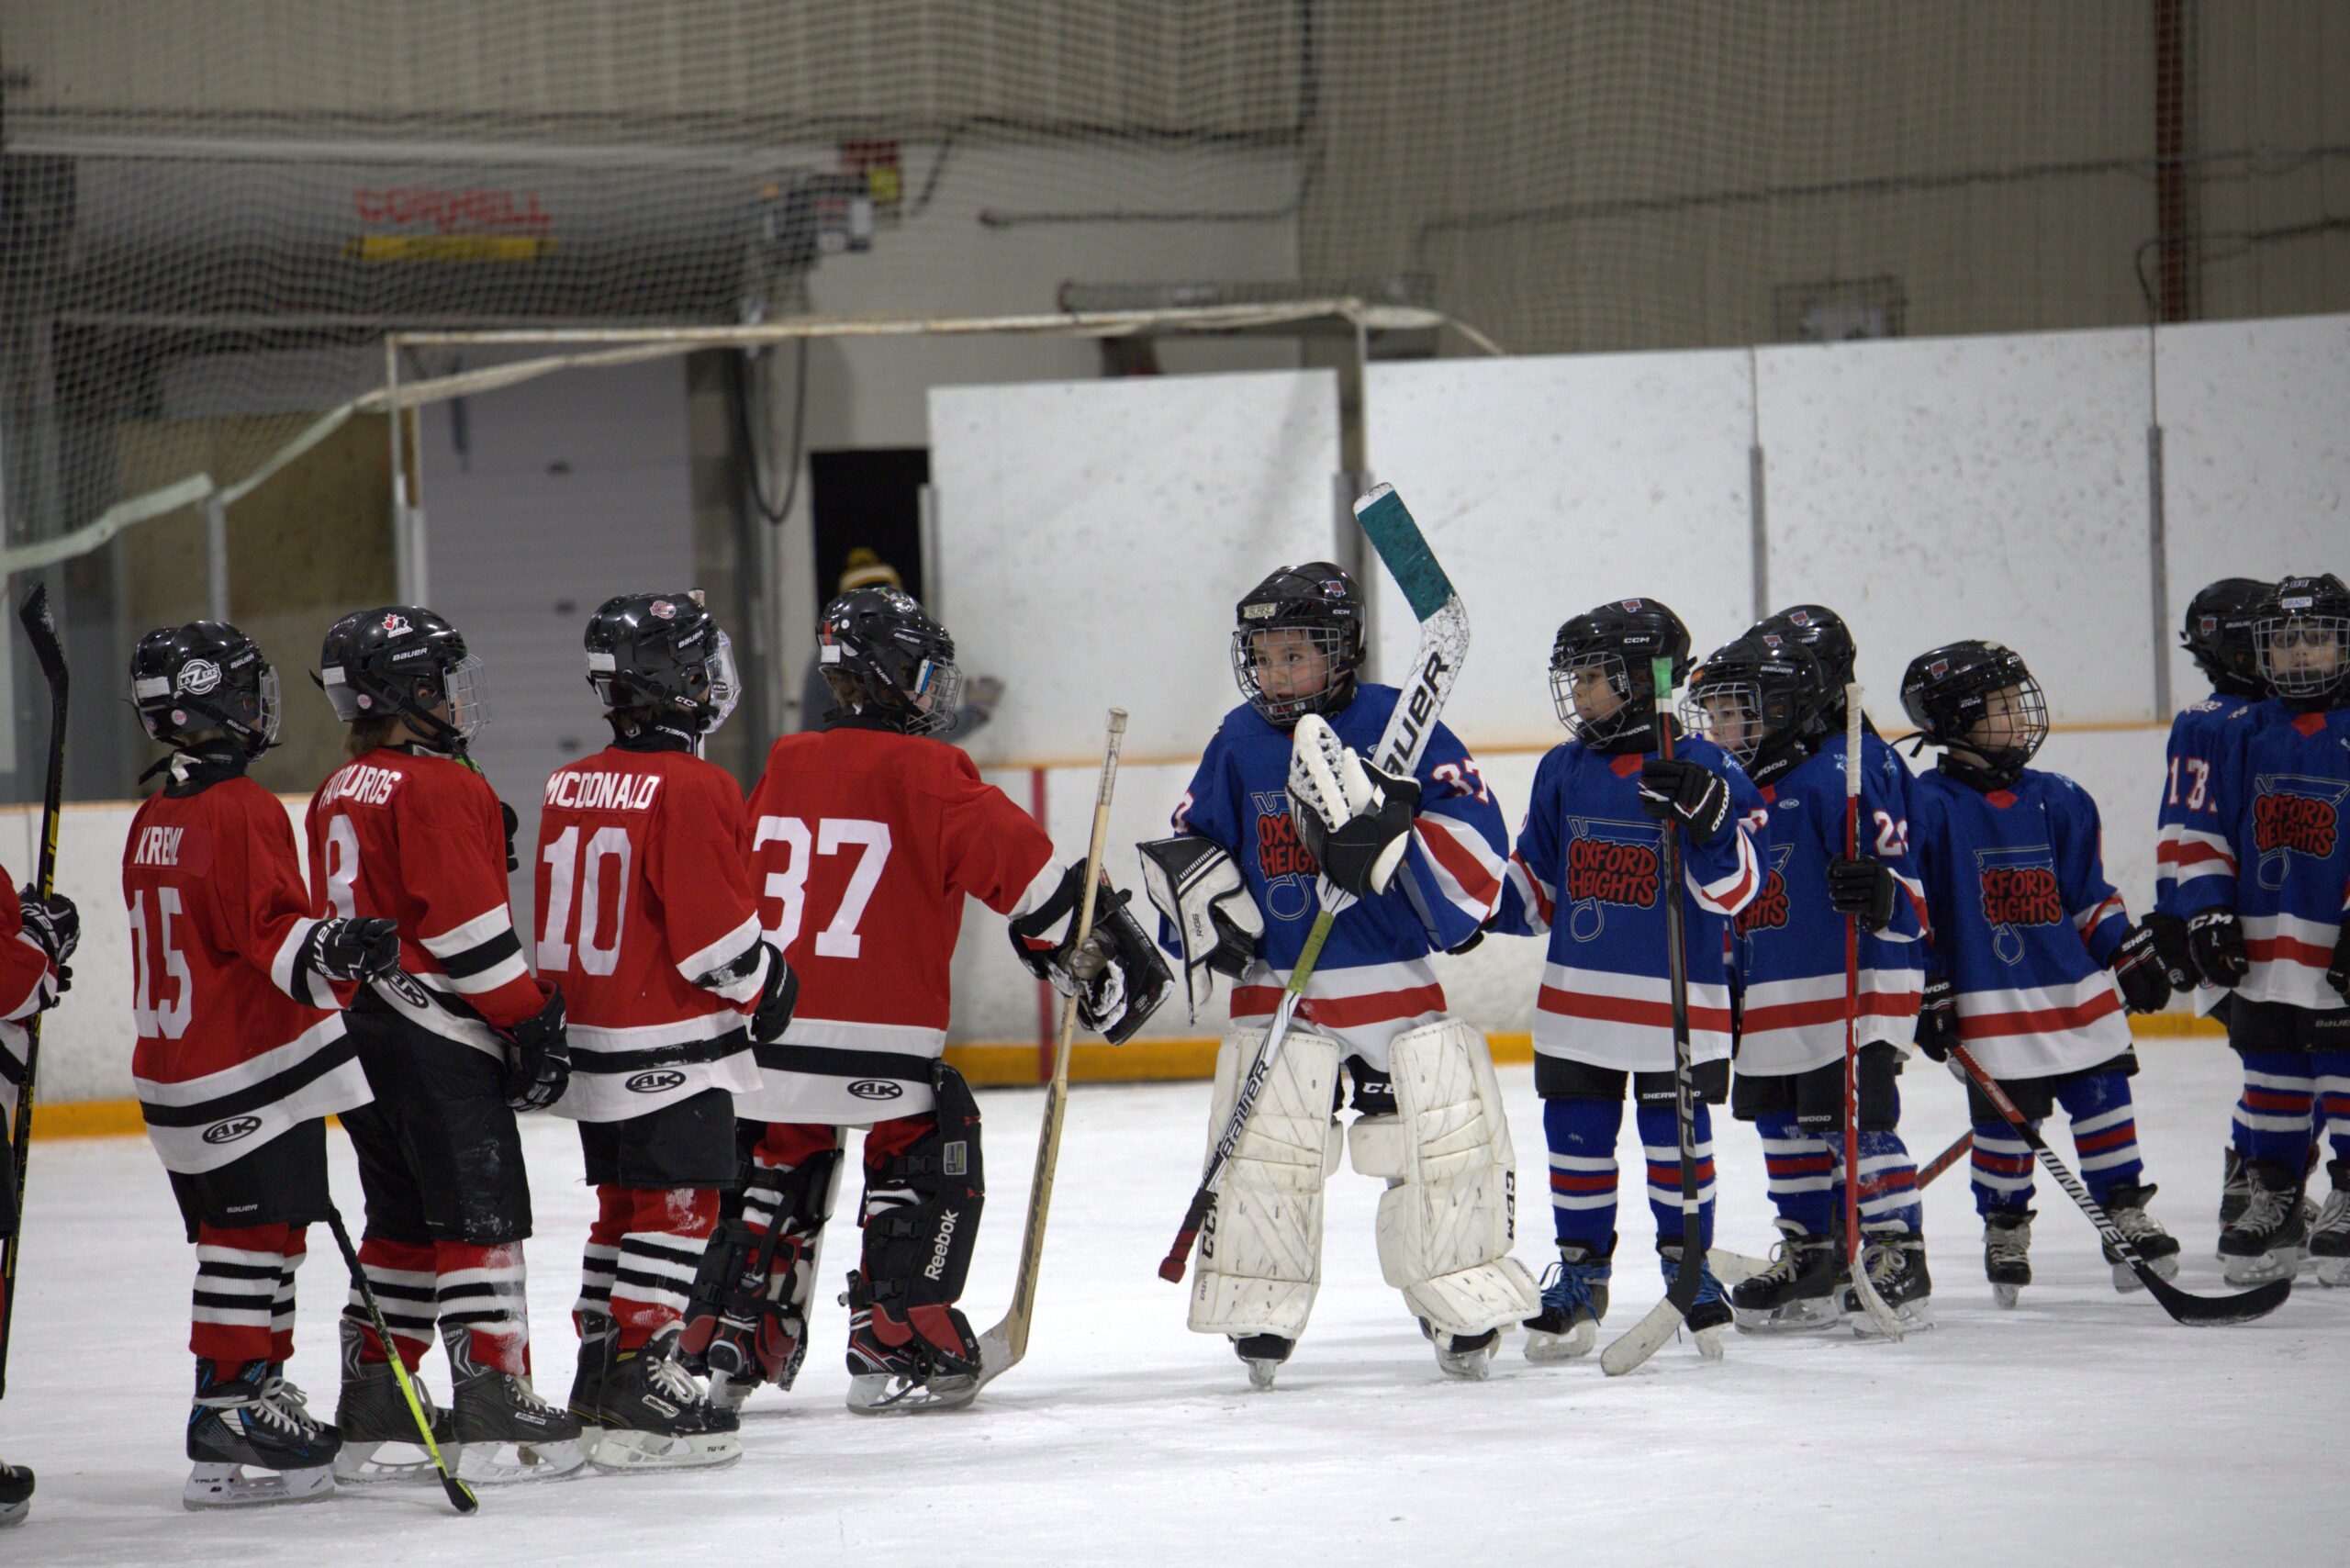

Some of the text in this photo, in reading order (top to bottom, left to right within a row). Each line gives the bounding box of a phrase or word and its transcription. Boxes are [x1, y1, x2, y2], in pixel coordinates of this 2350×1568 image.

[393, 647, 428, 661] BAUER
[677, 630, 704, 648] BAUER
[894, 633, 921, 644] BAUER
[230, 654, 254, 668] BAUER
[227, 719, 251, 734] BAUER
[1383, 652, 1450, 777] AUER
[544, 772, 661, 811] MCDONALD
[1433, 758, 1489, 804] 37
[2255, 793, 2335, 828] OXFORD
[1569, 837, 1658, 876] OXFORD
[2257, 823, 2335, 856] HEIGHTS
[537, 825, 632, 976] 10
[753, 815, 891, 958] 37
[1568, 869, 1658, 905] HEIGHTS
[1980, 868, 2057, 898] XFORD
[1985, 895, 2062, 924] EIGHTS
[2190, 913, 2233, 932] CM
[129, 887, 192, 1039] 15
[1221, 1058, 1269, 1160] BAUER
[1642, 1090, 1701, 1100] SHERWD
[1679, 1040, 1696, 1159] CCM
[227, 1204, 258, 1214] BAUER
[1016, 1081, 1057, 1319] SHERWOOD
[1505, 1170, 1516, 1241] CCM
[2037, 1148, 2146, 1271] WINNWELL
[924, 1208, 959, 1282] Reebok
